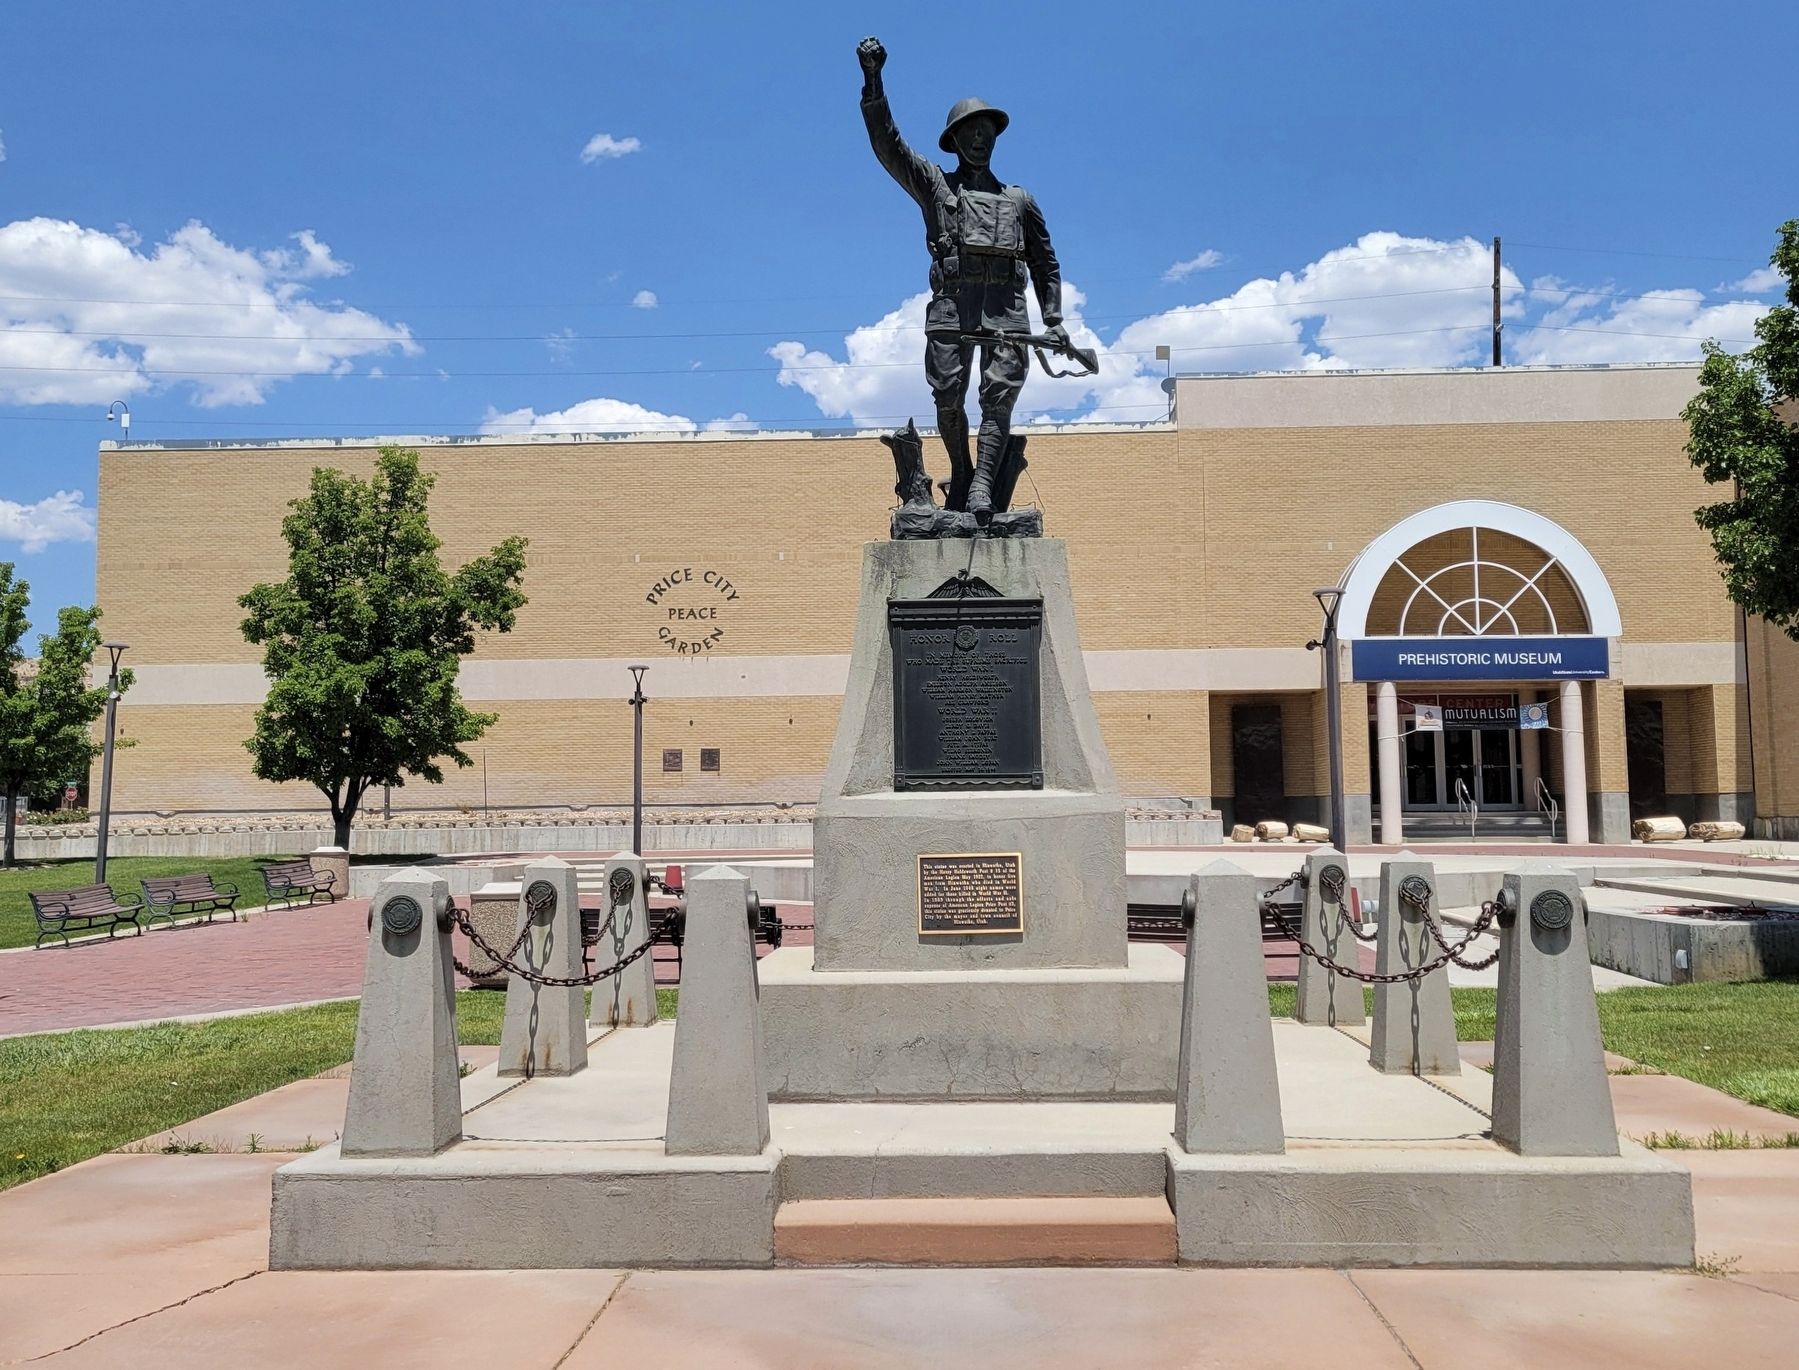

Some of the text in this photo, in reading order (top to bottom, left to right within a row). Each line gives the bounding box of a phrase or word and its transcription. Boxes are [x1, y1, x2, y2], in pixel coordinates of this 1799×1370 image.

[646, 568, 739, 605] PRICE CITY
[668, 608, 717, 620] PEACE
[659, 627, 724, 654] GARDEN
[910, 634, 1018, 644] HONOR ROLL
[1399, 653, 1562, 665] PREHISTORIC MUSEUM
[1447, 698, 1504, 709] CENTER
[1445, 708, 1517, 719] MUTUALISM
